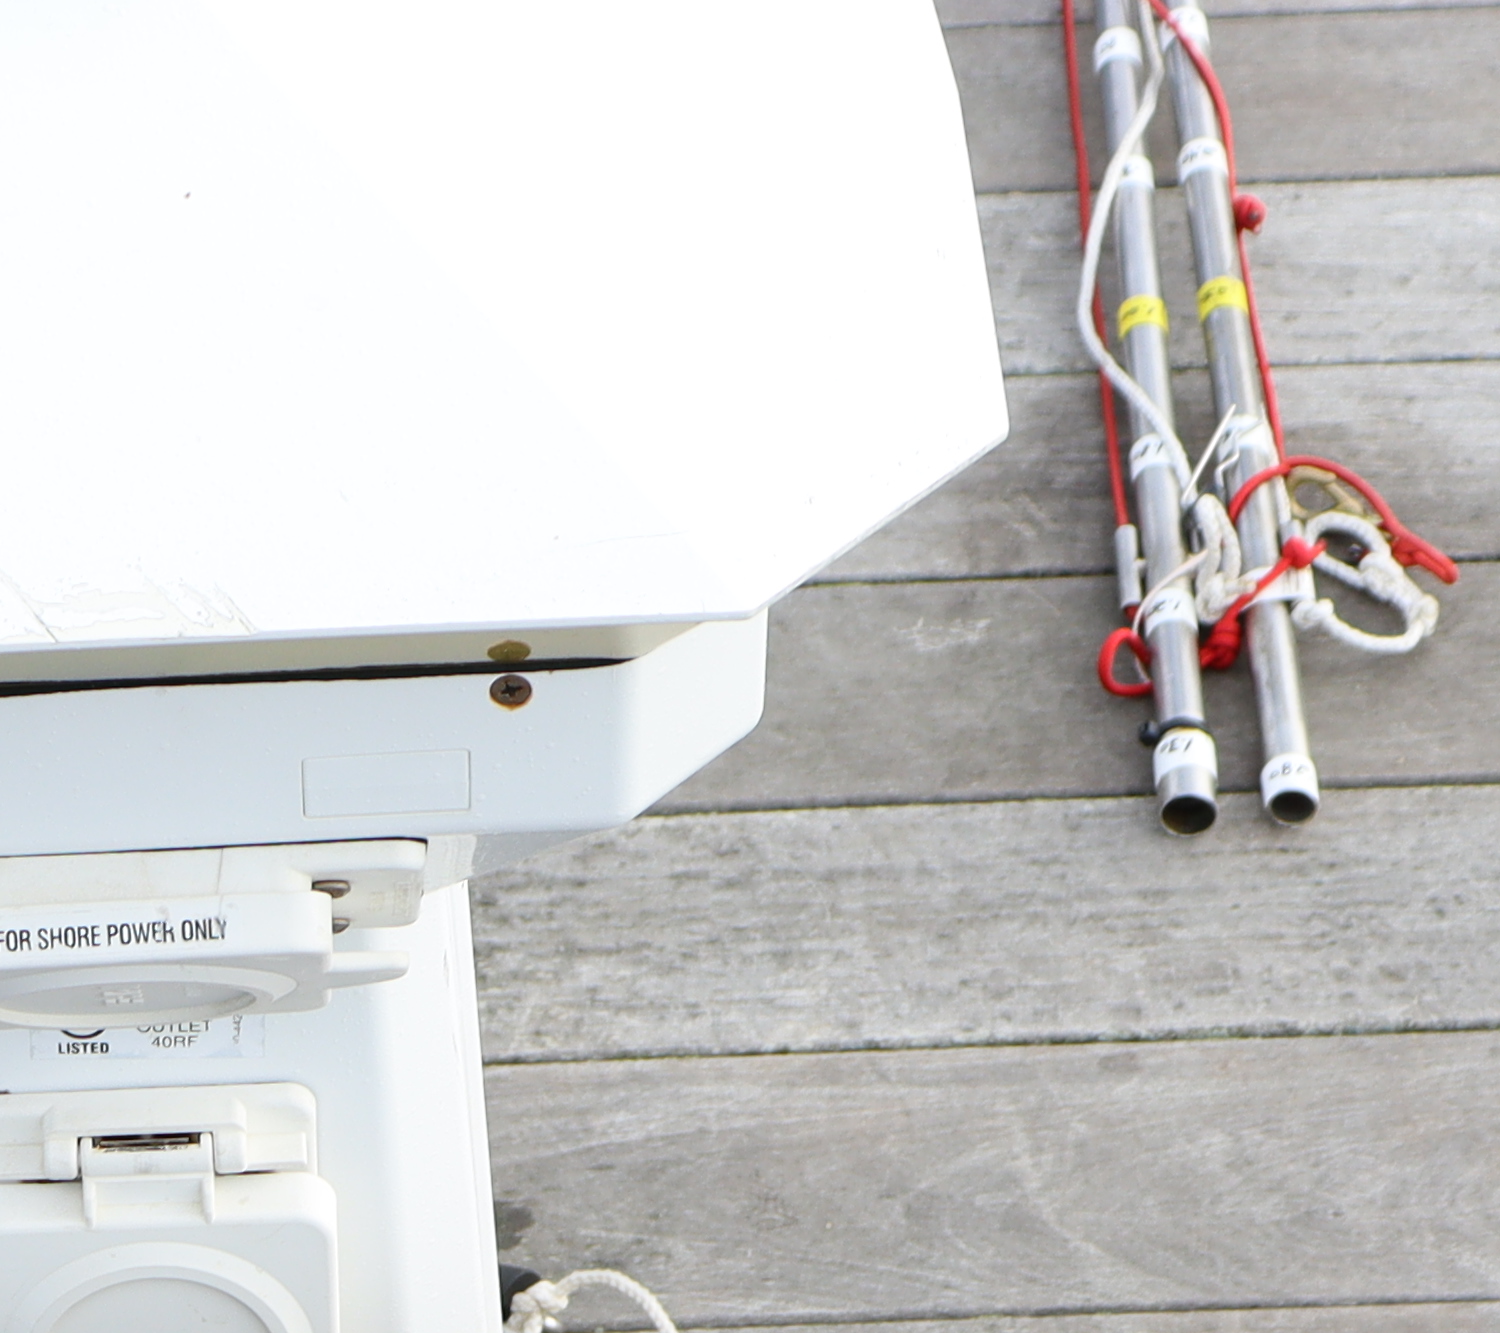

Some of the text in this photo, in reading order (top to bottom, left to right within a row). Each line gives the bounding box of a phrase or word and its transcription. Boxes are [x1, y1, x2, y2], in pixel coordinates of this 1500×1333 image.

[37, 924, 101, 951] SHORE
[106, 920, 175, 947] POWER
[181, 916, 227, 942] ONLY
[57, 1040, 111, 1056] LISTED
